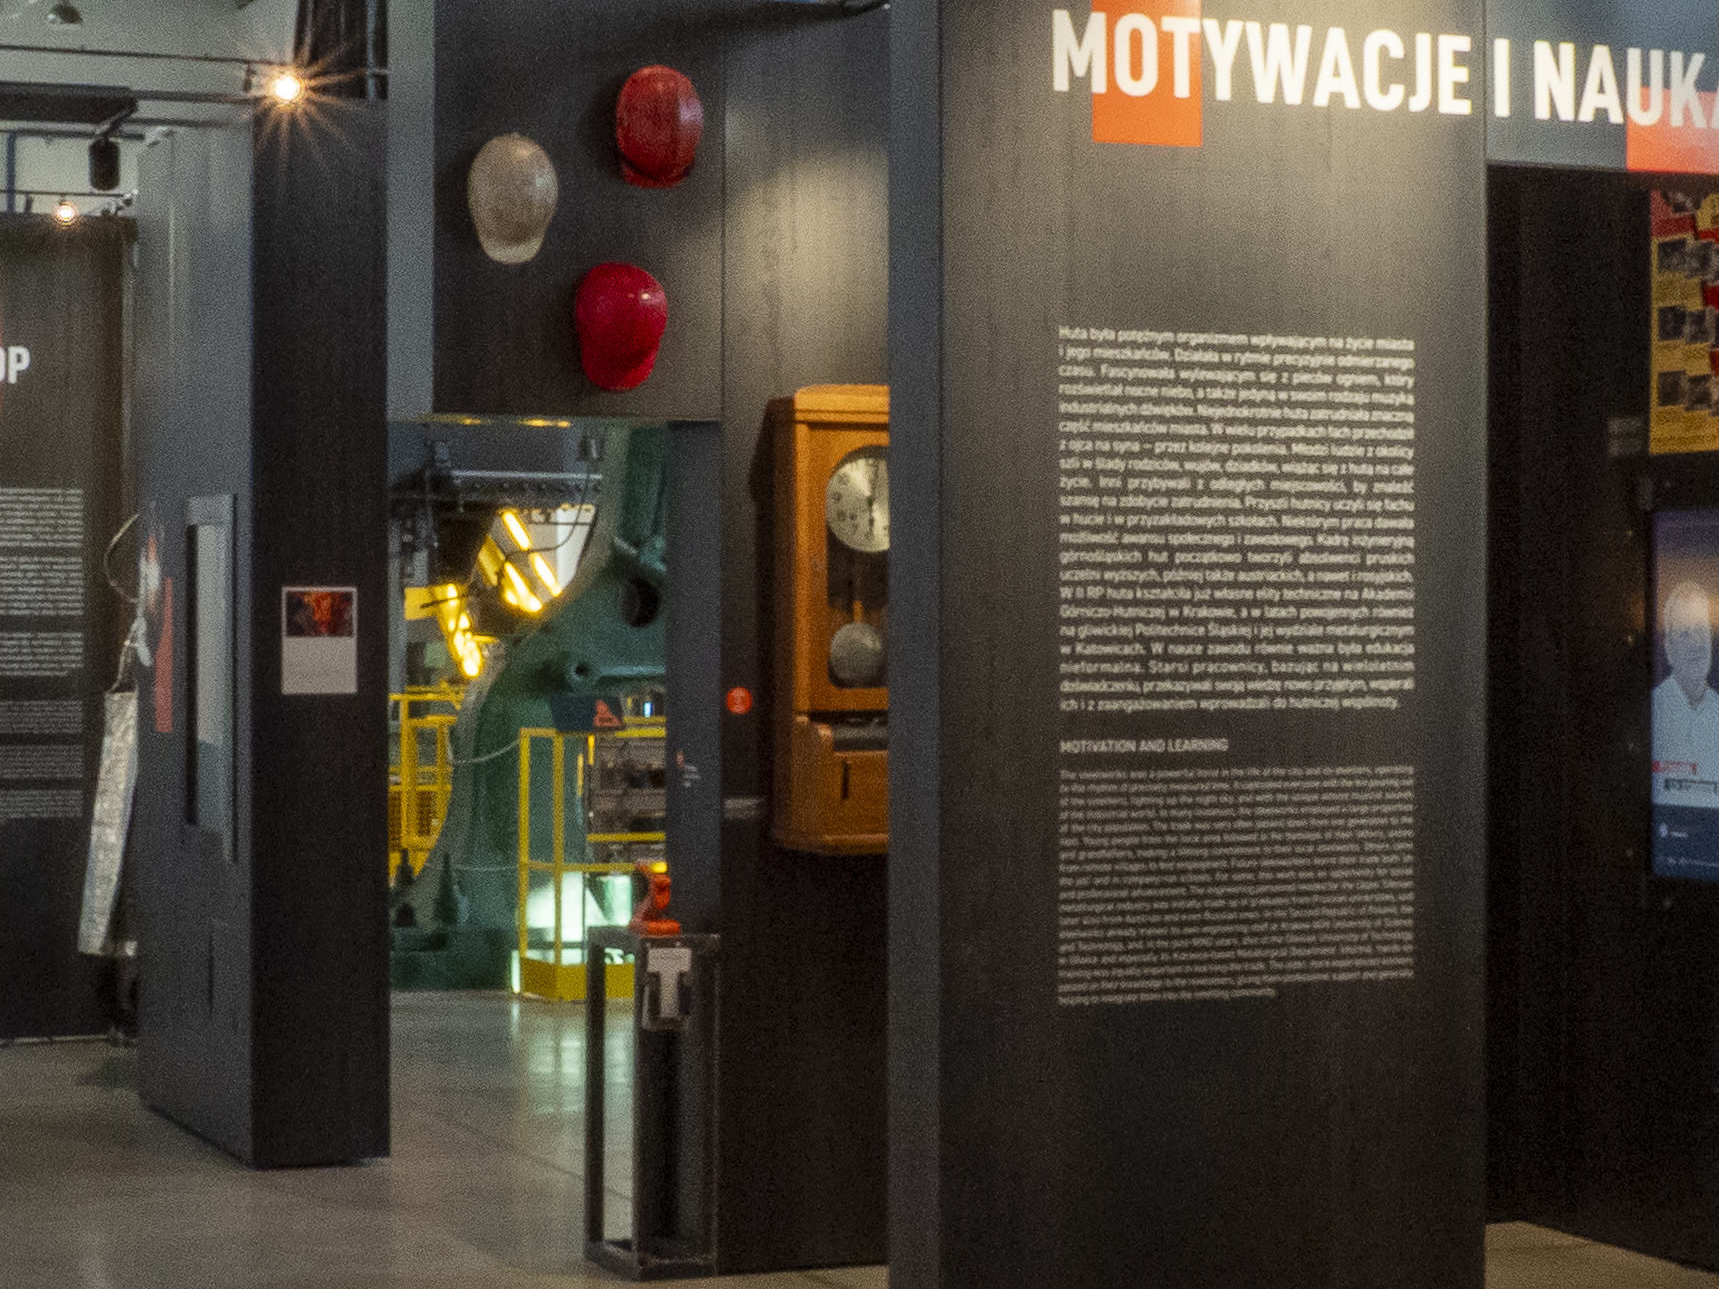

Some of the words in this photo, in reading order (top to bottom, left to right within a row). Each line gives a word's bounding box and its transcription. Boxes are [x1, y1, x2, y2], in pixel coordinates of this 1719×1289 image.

[1051, 9, 1472, 116] MOTYWACJE
[1493, 37, 1510, 118] I
[1059, 738, 1137, 753] MOTIVATION
